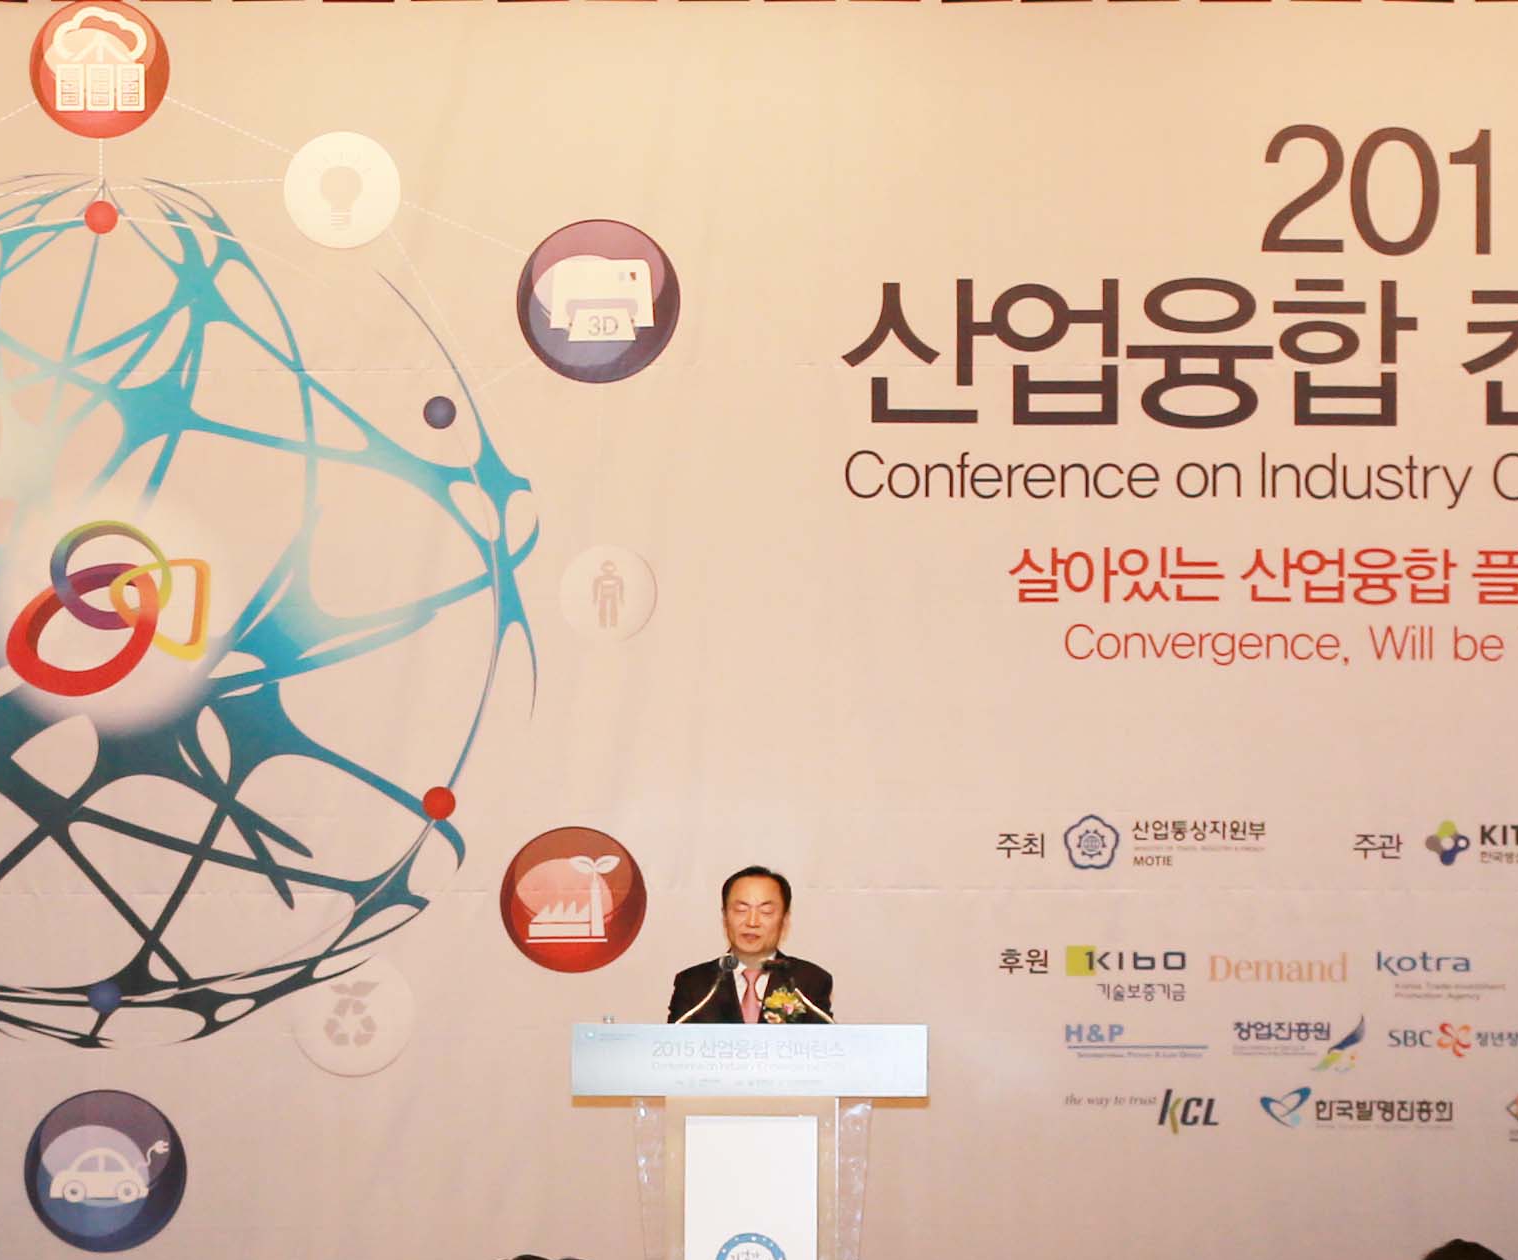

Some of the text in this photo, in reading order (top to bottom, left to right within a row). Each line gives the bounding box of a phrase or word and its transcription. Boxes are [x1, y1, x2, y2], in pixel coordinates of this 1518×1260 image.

[588, 315, 619, 336] 3D
[842, 277, 1417, 429] 산업융합
[845, 449, 1160, 502] Conference
[1177, 463, 1243, 502] on
[1259, 450, 1473, 510] Industry
[1008, 546, 1225, 604] 살아있는
[1241, 547, 1457, 604] 산업융합
[1063, 622, 1352, 667] Convergence,
[1369, 624, 1434, 662] Will
[1453, 625, 1505, 664] be
[1132, 820, 1267, 842] 산업통상자원부
[996, 833, 1046, 860] 주최
[1353, 833, 1404, 861] 주관
[1133, 856, 1173, 867] MOTIE
[999, 948, 1049, 974] 후원
[1208, 953, 1348, 983] Demand
[1376, 951, 1471, 977] kotra
[1097, 984, 1186, 1002] 기술보증기금
[1064, 1023, 1124, 1043] H&P
[1233, 1021, 1331, 1041] 창업진흥원
[1387, 1030, 1433, 1048] SBC
